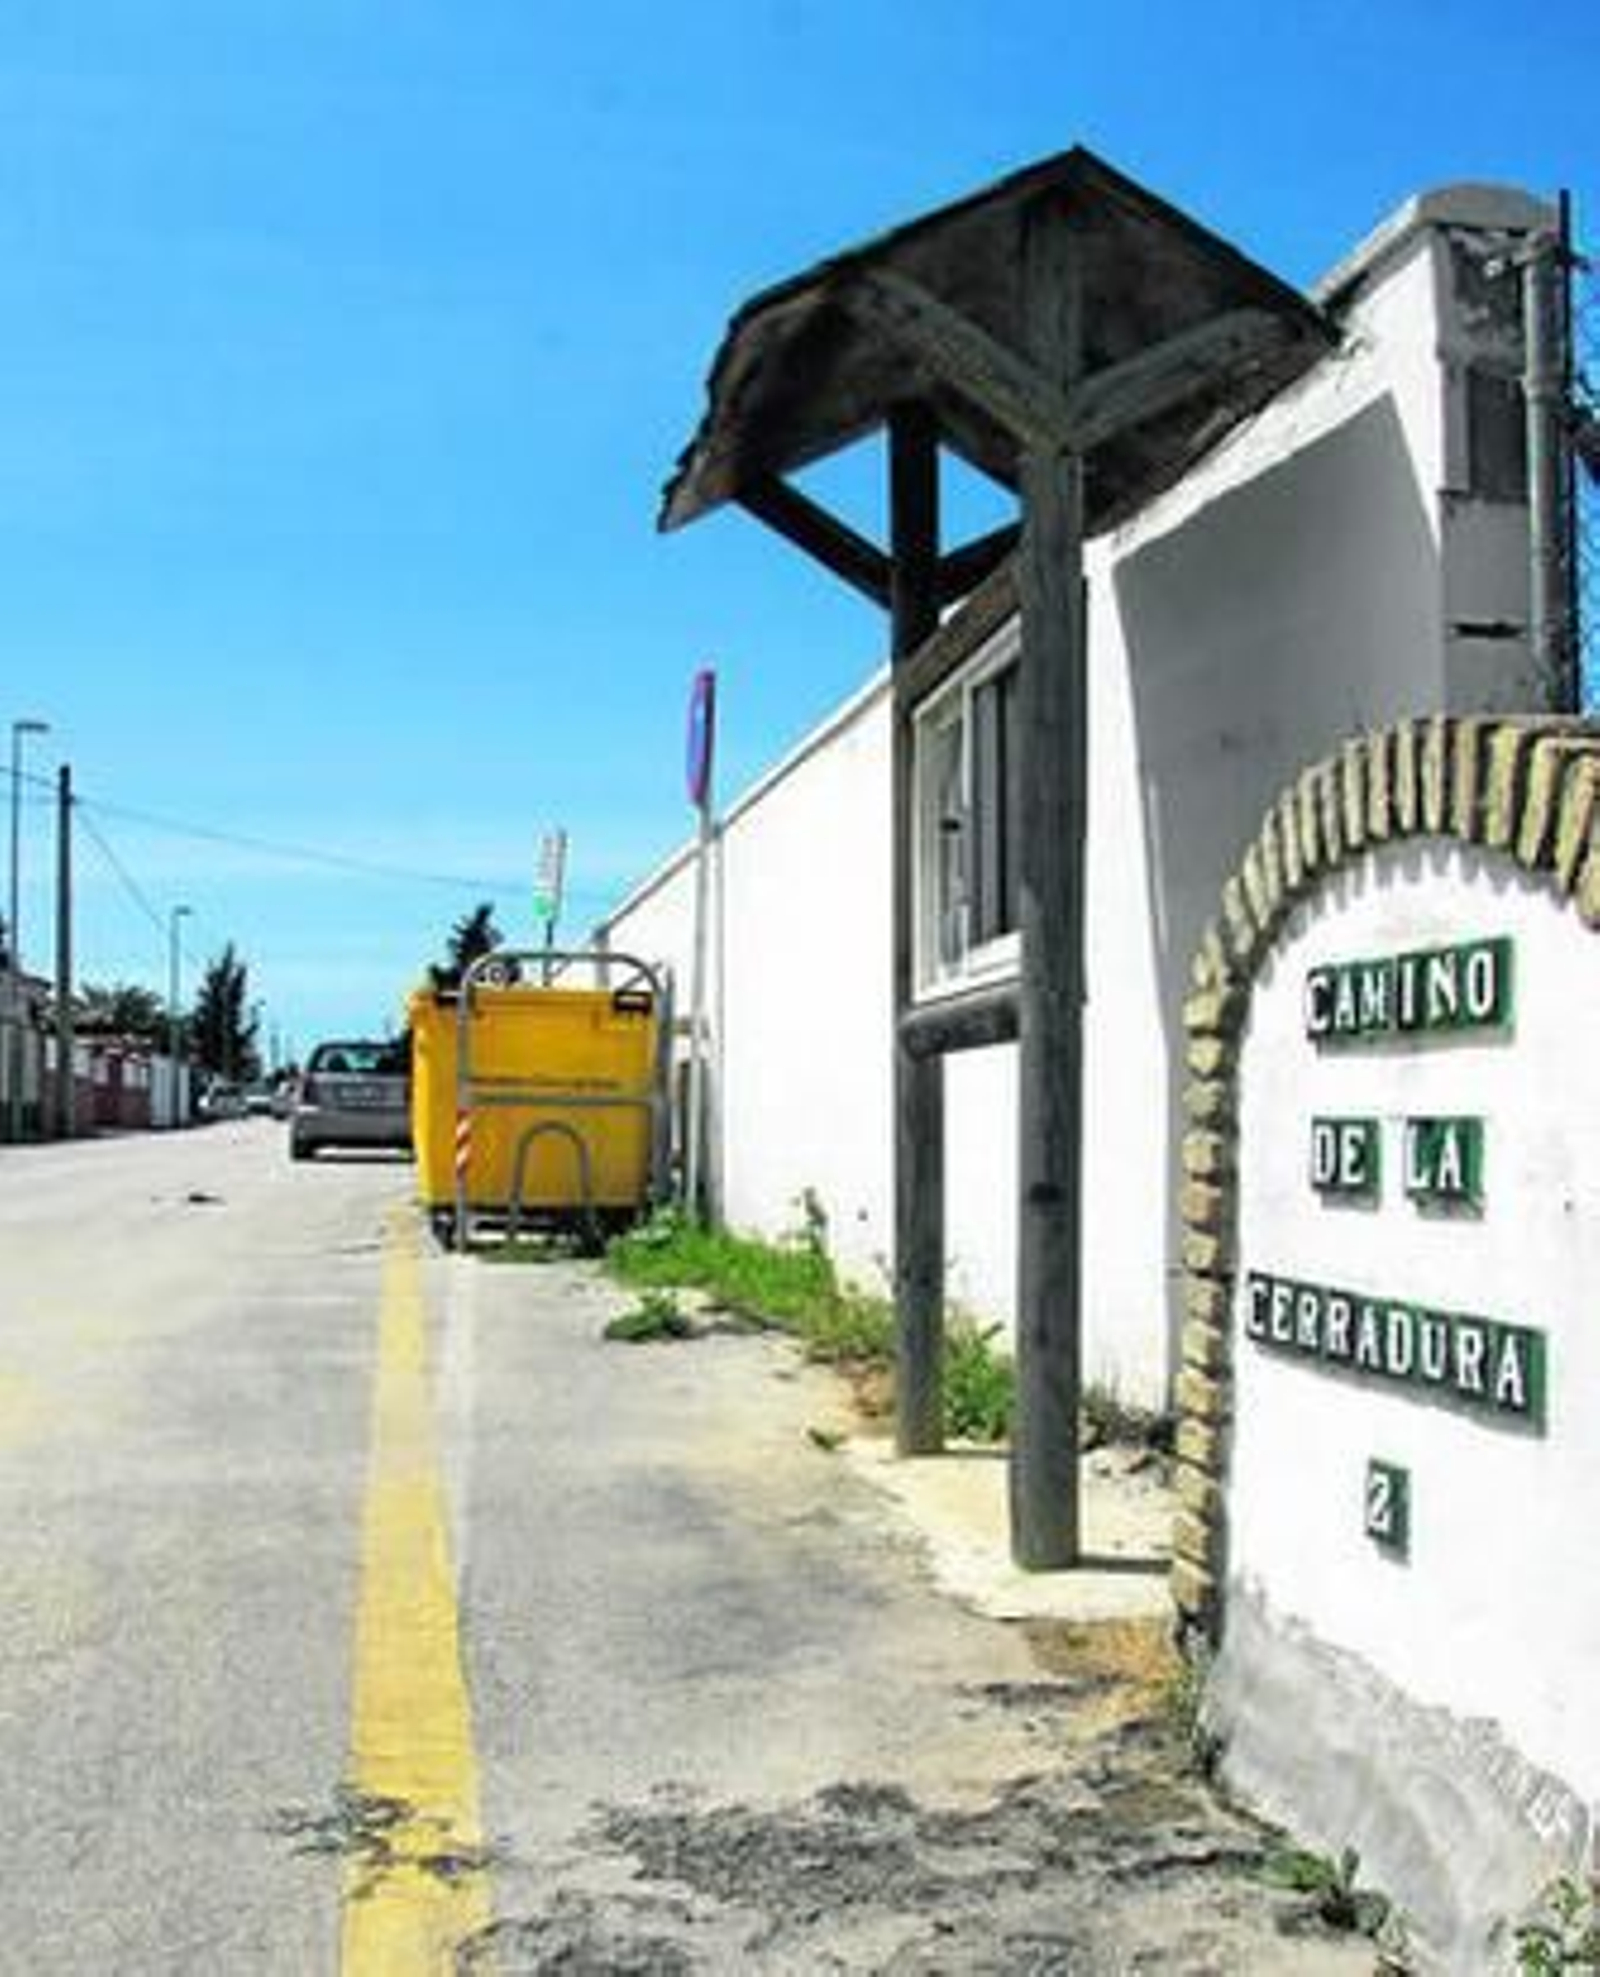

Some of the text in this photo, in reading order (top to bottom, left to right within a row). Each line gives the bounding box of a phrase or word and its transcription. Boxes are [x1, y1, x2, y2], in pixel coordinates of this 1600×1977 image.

[1307, 950, 1495, 1031] CAMINO
[1313, 1122, 1462, 1191] DE LA
[1249, 1280, 1525, 1407] CERRADURA
[1368, 1472, 1392, 1533] 2
